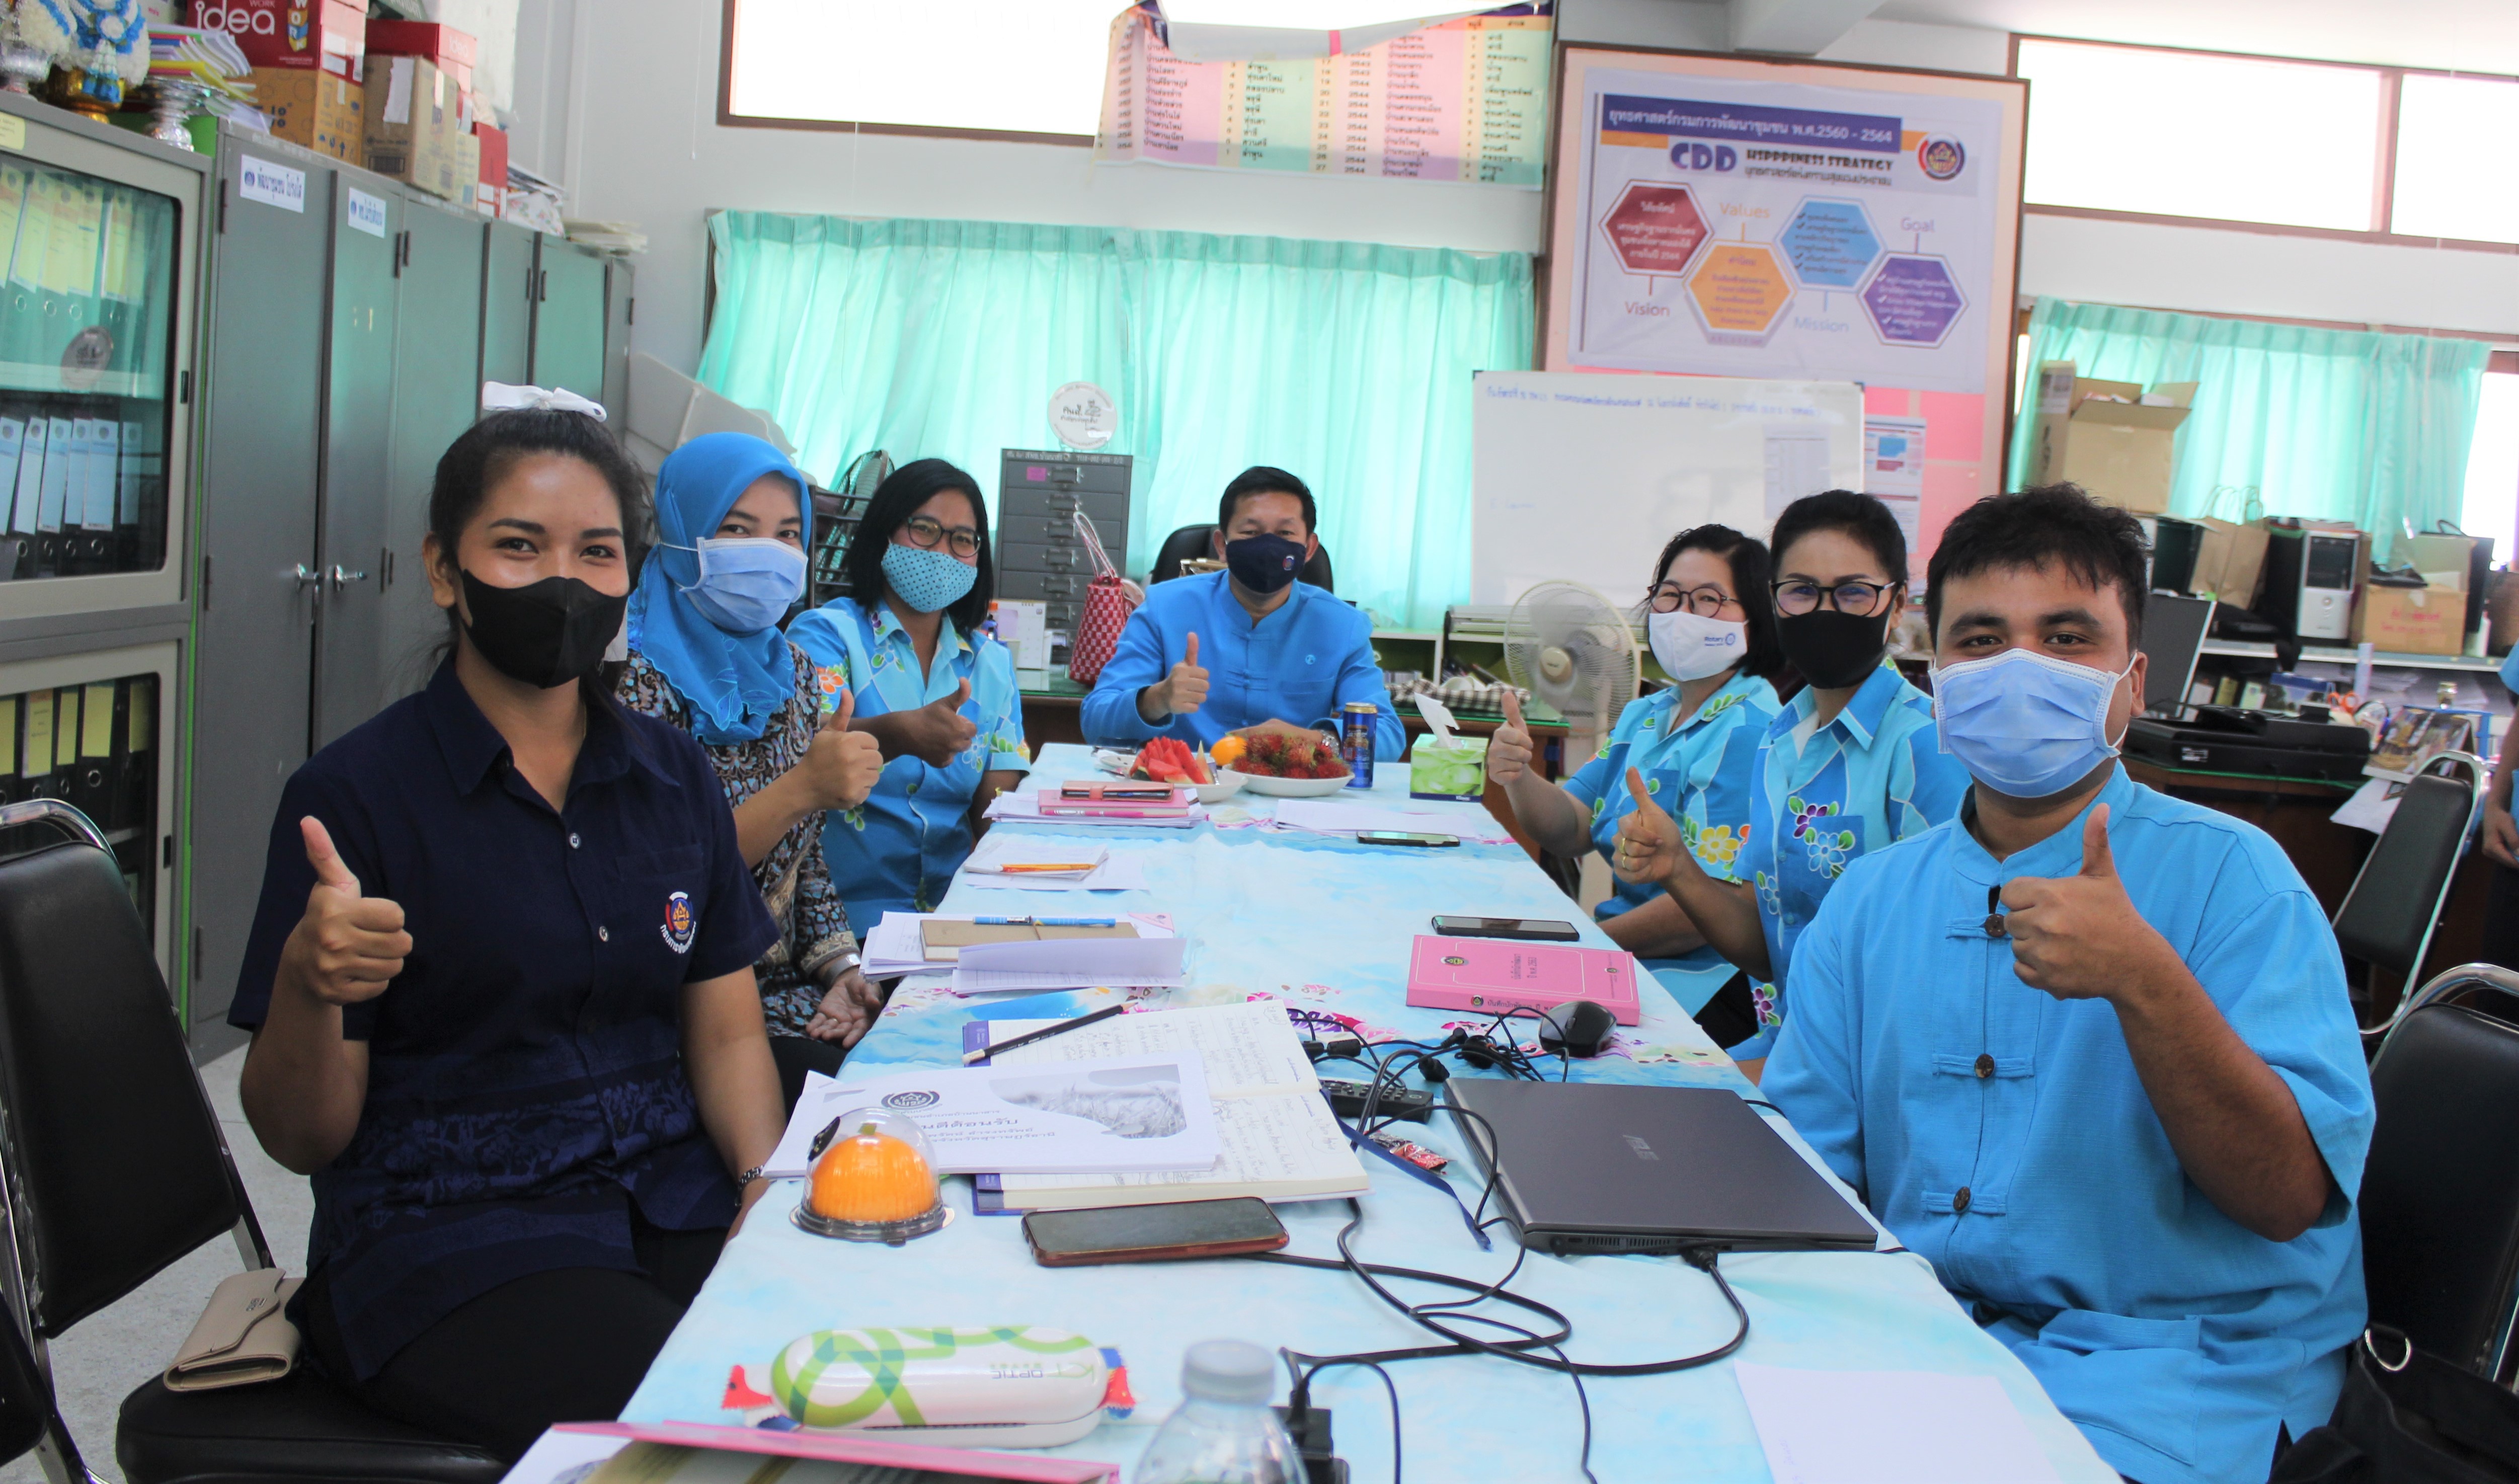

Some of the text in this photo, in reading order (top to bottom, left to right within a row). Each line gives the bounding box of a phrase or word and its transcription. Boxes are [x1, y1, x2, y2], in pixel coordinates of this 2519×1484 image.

[195, 0, 275, 35] idea
[1860, 128, 1893, 143] 2564
[1671, 142, 1737, 172] CDD
[1828, 155, 1894, 171] STRATEGY
[1719, 202, 1770, 219] Values
[1901, 217, 1935, 233] Goal
[1625, 301, 1670, 317] Vision
[1794, 317, 1850, 333] Mission
[921, 1116, 1018, 1130] นดีต้อนรับ
[931, 1131, 1055, 1143] รจังหวัดสุราษฎร์ธานี
[1622, 1135, 1660, 1160] ASUS
[991, 1370, 1044, 1379] OPTIC
